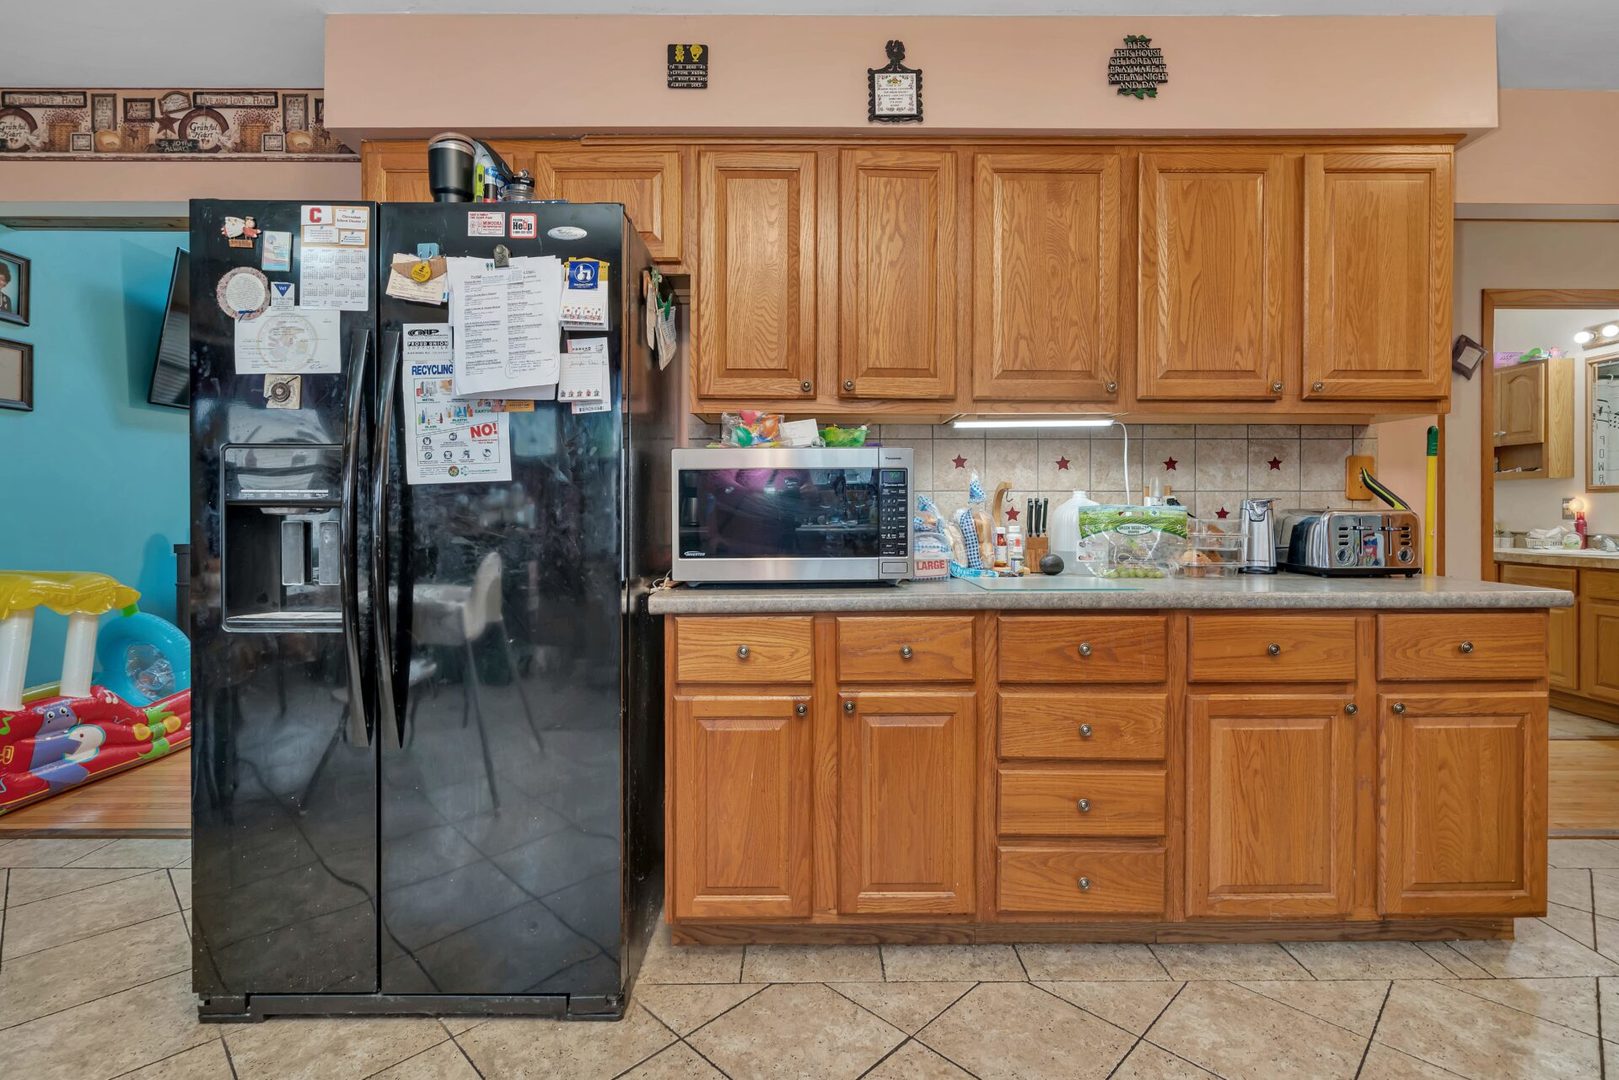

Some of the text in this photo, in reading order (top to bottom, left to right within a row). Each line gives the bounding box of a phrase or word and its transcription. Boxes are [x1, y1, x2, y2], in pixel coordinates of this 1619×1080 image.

[1110, 65, 1131, 73] PRAY
[1108, 73, 1128, 81] SAFE
[1143, 73, 1168, 81] NIGHT
[1119, 81, 1139, 89] AND
[309, 207, 322, 223] C
[411, 364, 454, 376] RECYCLING
[469, 422, 498, 438] NO!
[916, 559, 945, 571] LARGE
